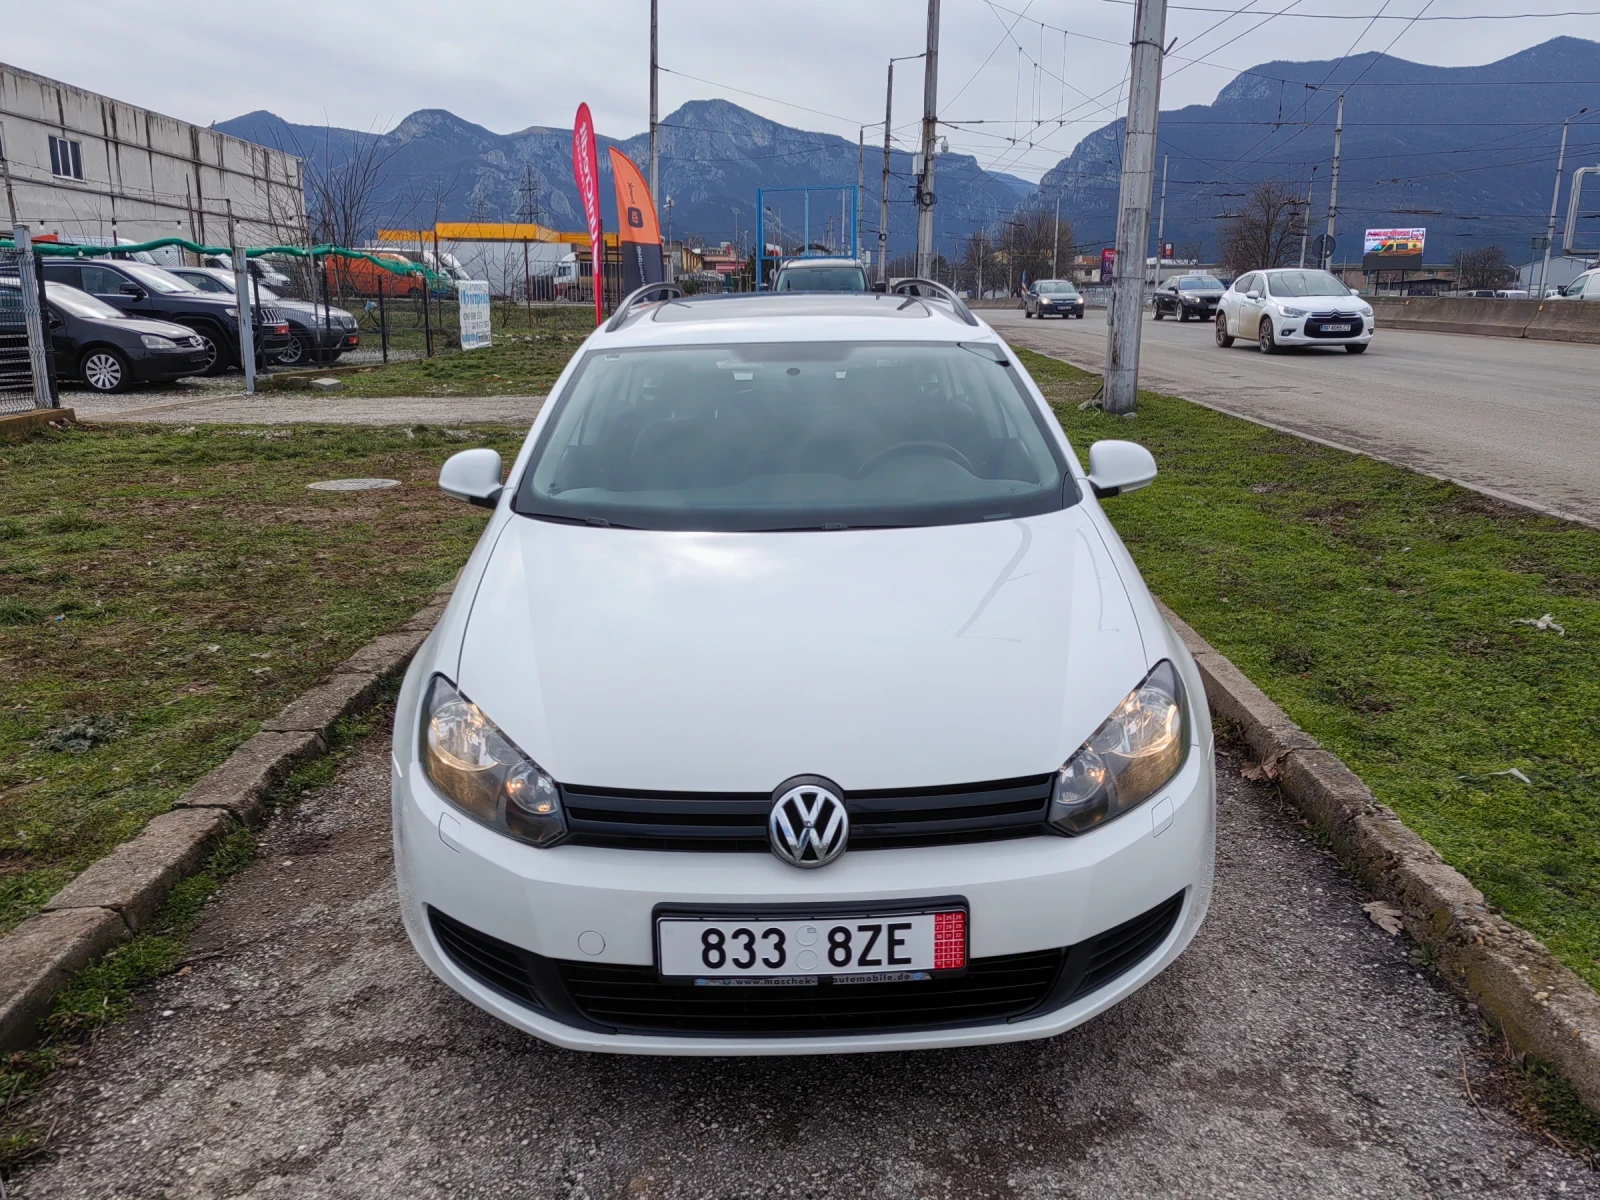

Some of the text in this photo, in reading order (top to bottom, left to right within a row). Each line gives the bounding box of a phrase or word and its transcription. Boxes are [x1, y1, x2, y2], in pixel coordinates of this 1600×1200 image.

[701, 922, 912, 969] 833 8ZE
[735, 977, 817, 986] www.moschek-
